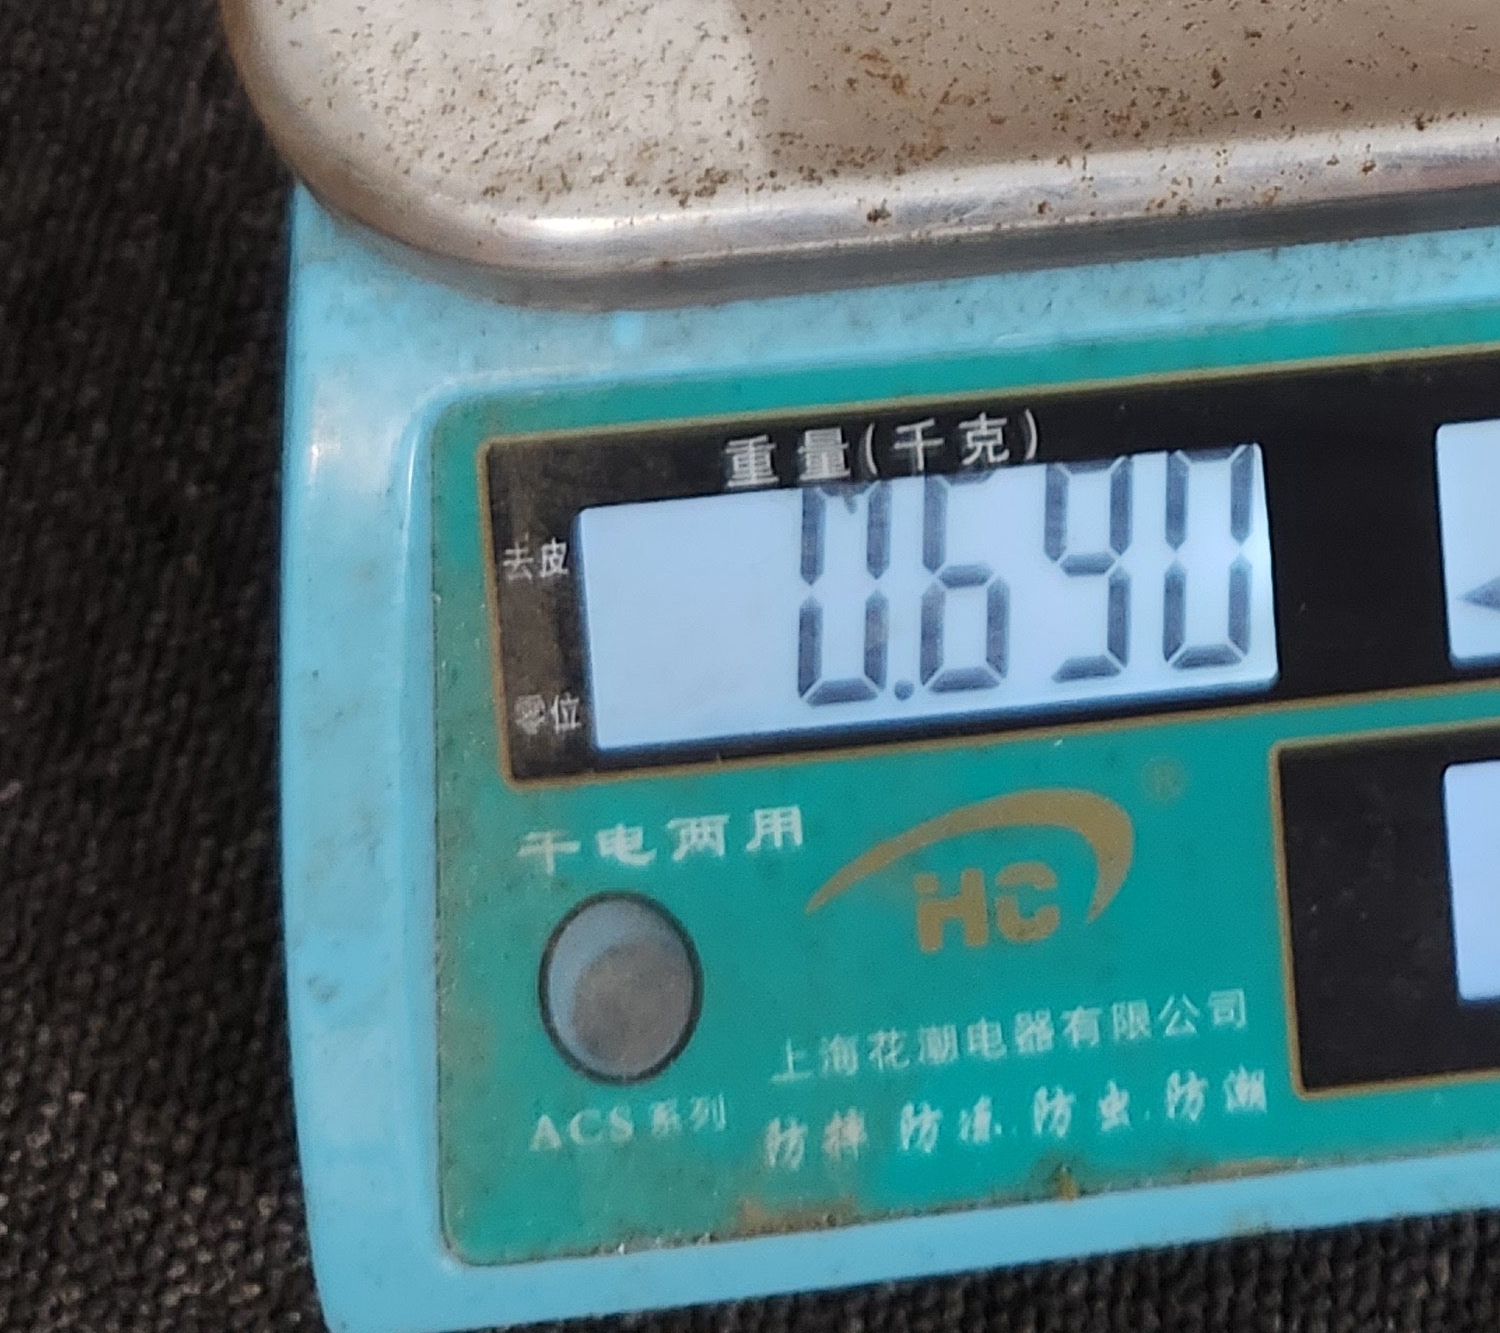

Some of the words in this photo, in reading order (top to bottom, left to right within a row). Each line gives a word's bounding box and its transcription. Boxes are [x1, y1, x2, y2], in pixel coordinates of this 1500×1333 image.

[722, 410, 1040, 490] 重量(千克)
[503, 536, 570, 581] 去皮
[914, 860, 1060, 953] HC
